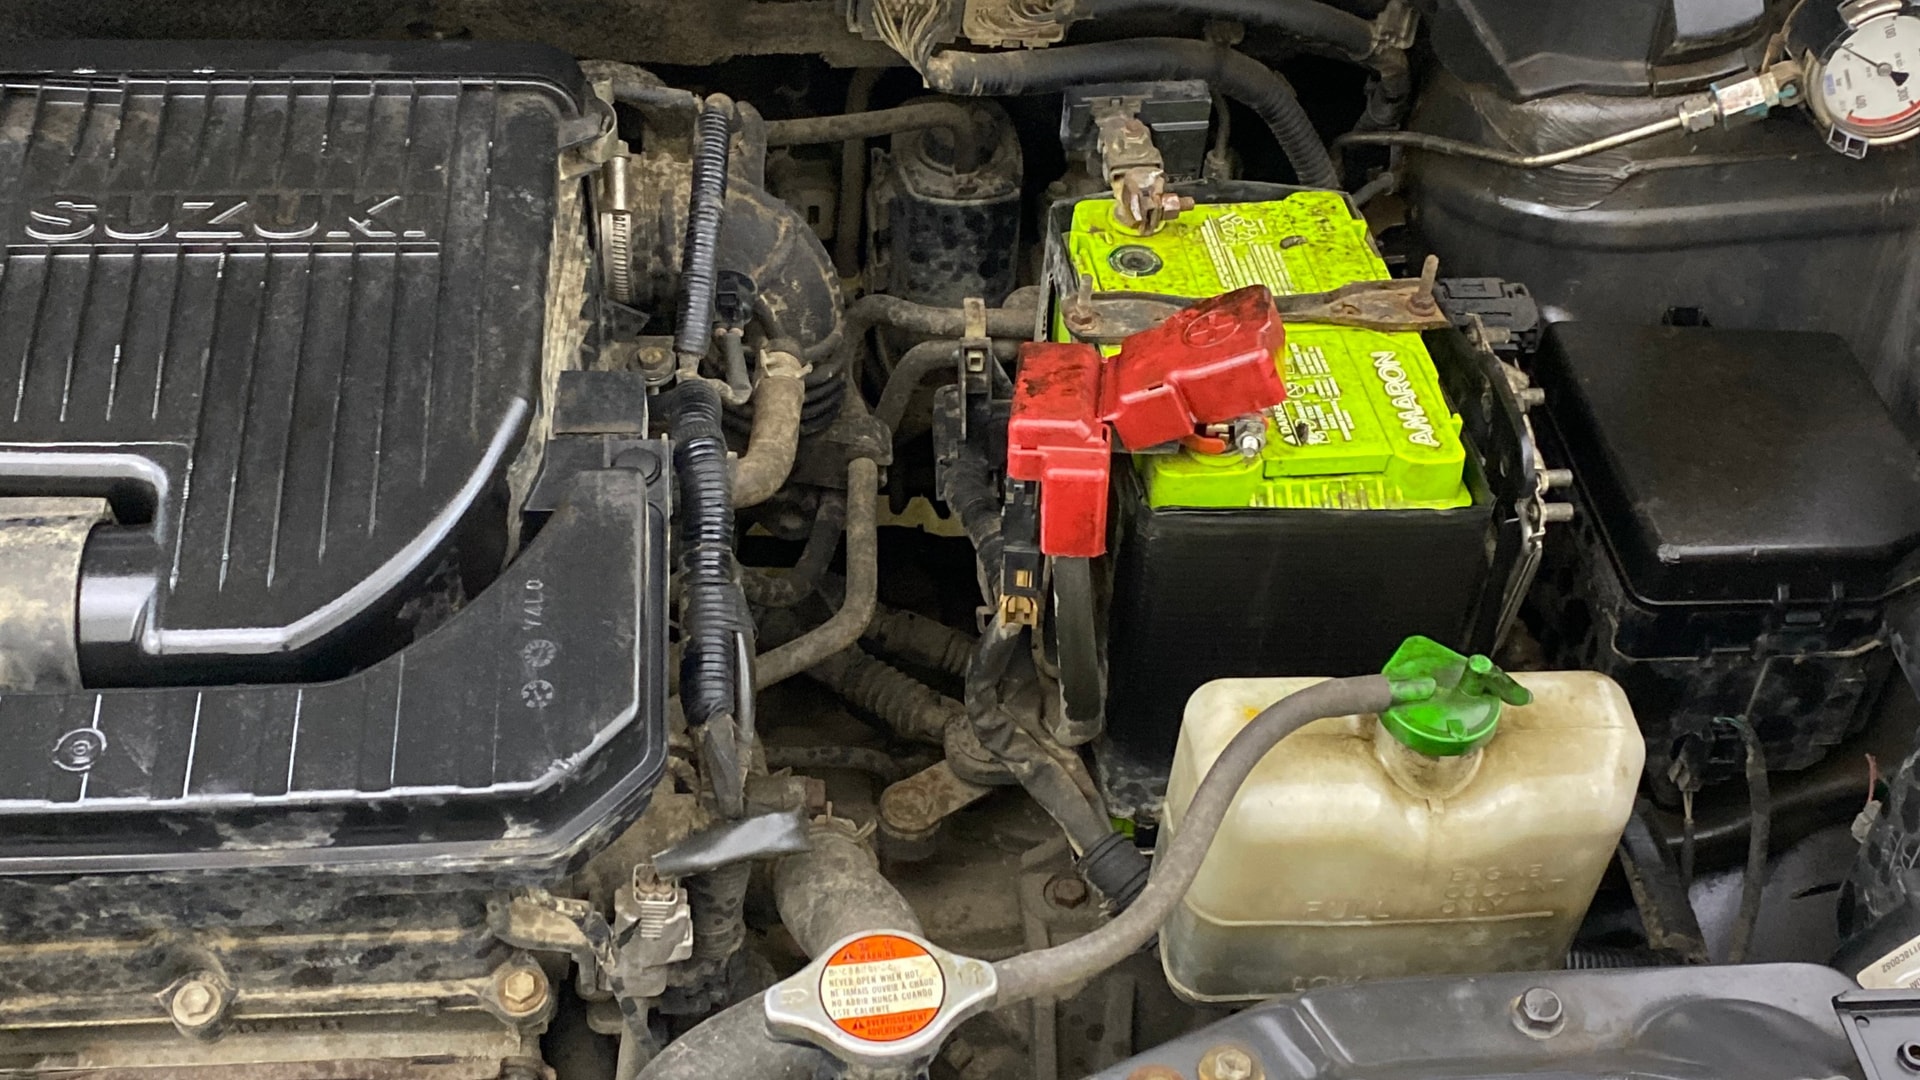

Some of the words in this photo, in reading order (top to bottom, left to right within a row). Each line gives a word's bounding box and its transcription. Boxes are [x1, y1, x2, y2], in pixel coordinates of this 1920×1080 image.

[1370, 351, 1441, 449] AMARON
[1273, 403, 1293, 435] DANGE
[1303, 900, 1390, 919] FULL
[829, 977, 856, 988] NEVER
[856, 976, 877, 986] OPEN
[881, 971, 902, 982] WHEN
[904, 969, 920, 979] HOT
[872, 993, 899, 1004] NUNCA
[901, 988, 933, 1001] CUANDO
